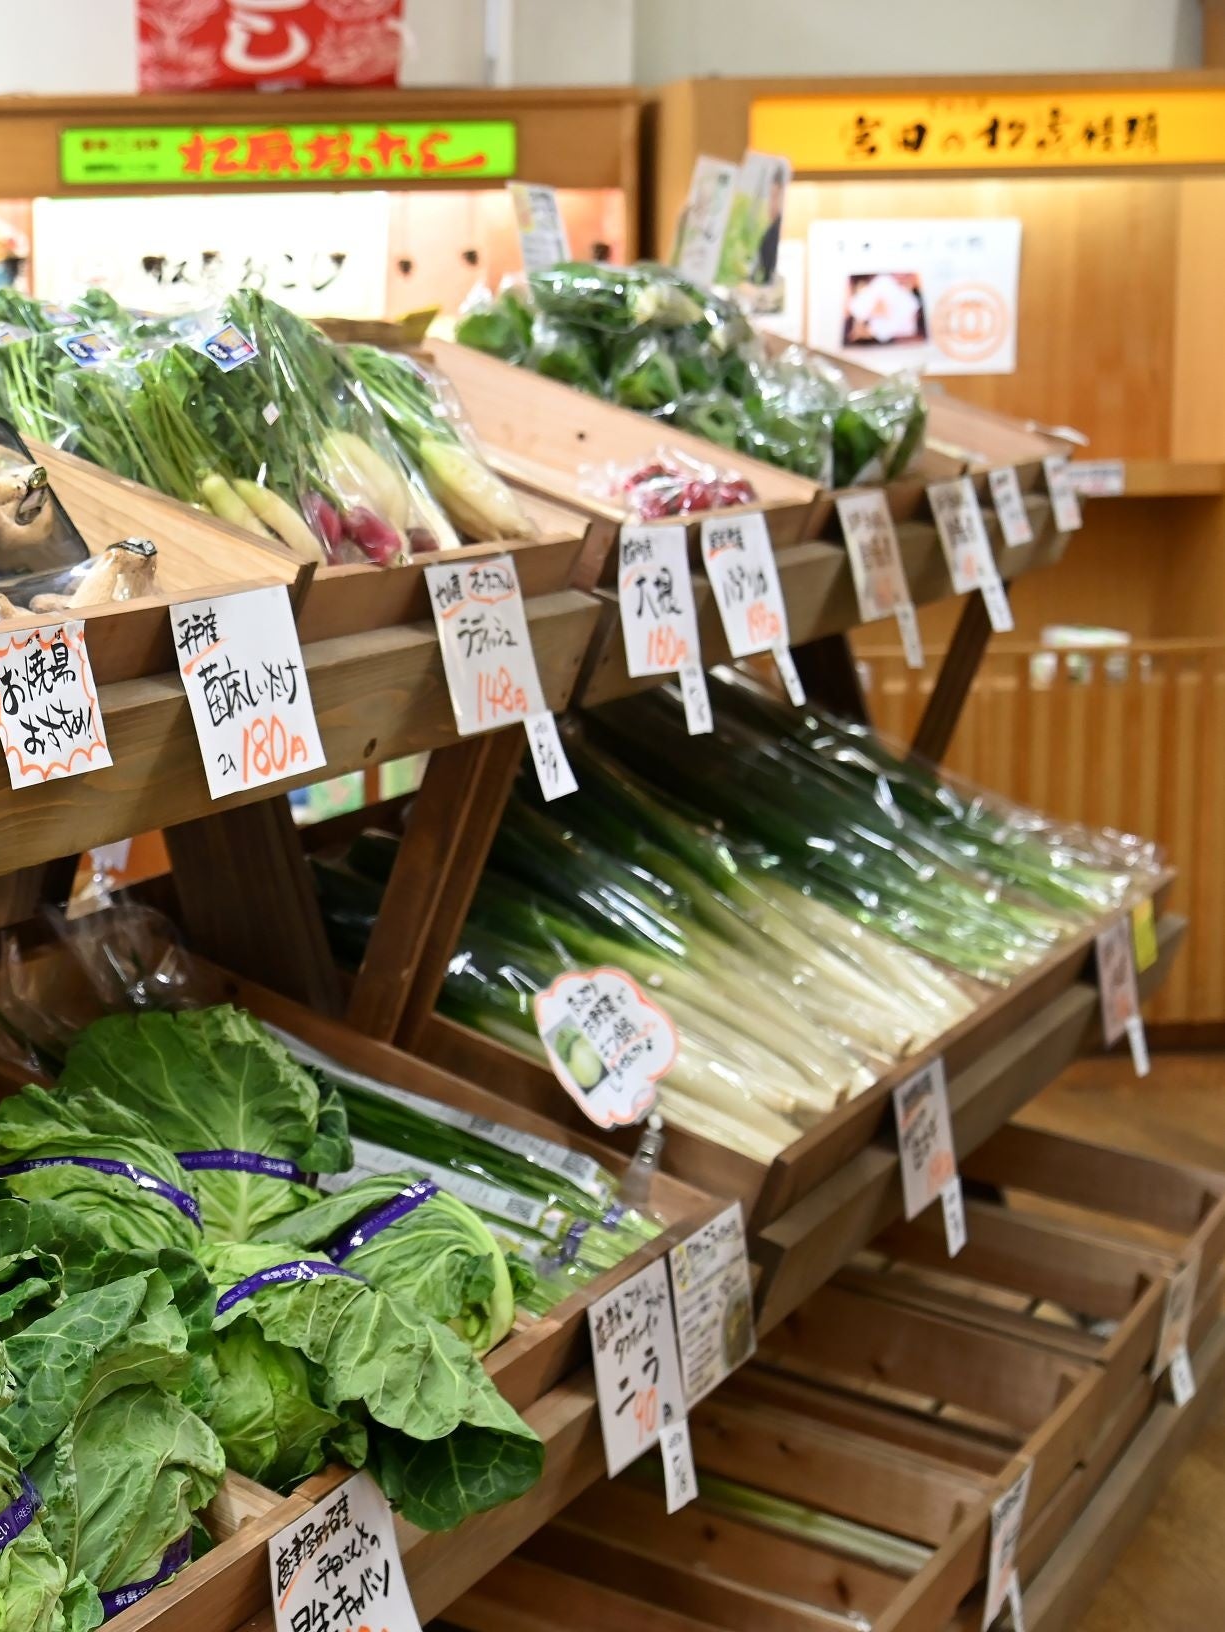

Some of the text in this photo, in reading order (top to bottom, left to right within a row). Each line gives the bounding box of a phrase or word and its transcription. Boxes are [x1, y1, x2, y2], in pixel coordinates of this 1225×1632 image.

[177, 607, 222, 656] 平戸産
[0, 643, 76, 716] お焼場
[198, 655, 298, 728] 菌床しいたけ
[476, 665, 529, 723] 148円
[242, 714, 308, 784] 180円
[615, 1346, 660, 1416] ニラ
